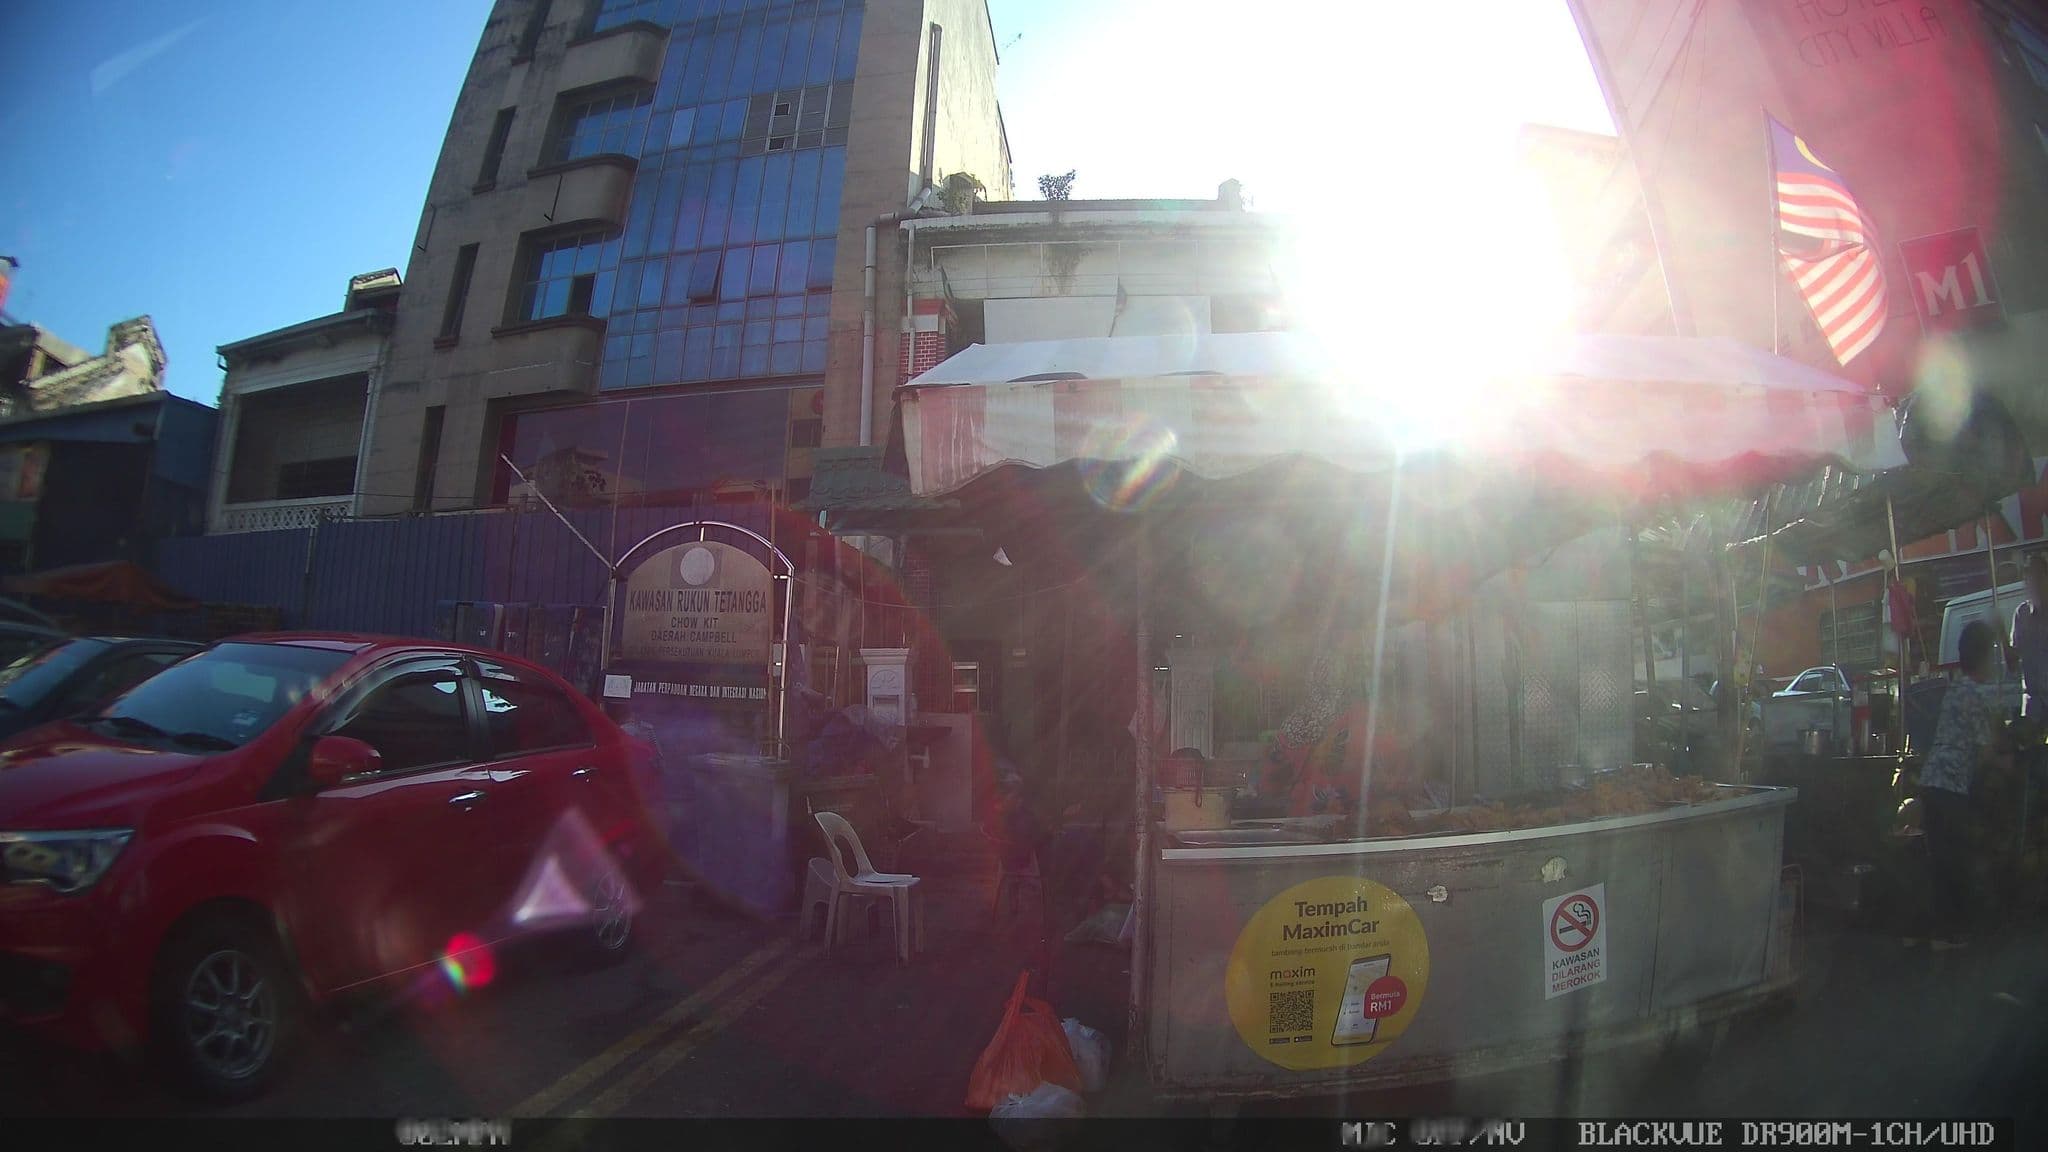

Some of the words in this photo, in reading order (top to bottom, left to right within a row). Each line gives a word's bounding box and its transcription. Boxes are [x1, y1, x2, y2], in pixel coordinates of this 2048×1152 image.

[1799, 27, 1859, 67] CITY
[1861, 6, 1948, 48] VILLA
[1914, 251, 1997, 316] M1
[629, 590, 673, 612] KAWASAN
[677, 590, 710, 612] RUKUN
[715, 590, 767, 613] TETANGGA
[671, 616, 698, 629] CHOW
[703, 617, 719, 629] KIT
[650, 630, 686, 641] DAERAH
[690, 631, 737, 643] CAMPBELL
[1294, 897, 1368, 918] Tempah
[1282, 919, 1380, 941] MaximCar
[1552, 948, 1600, 970] KAWASAN
[1552, 959, 1600, 981] DILARANG
[1270, 966, 1316, 979] maxim
[1552, 971, 1600, 993] MEROKOK
[1370, 1000, 1392, 1013] RM1
